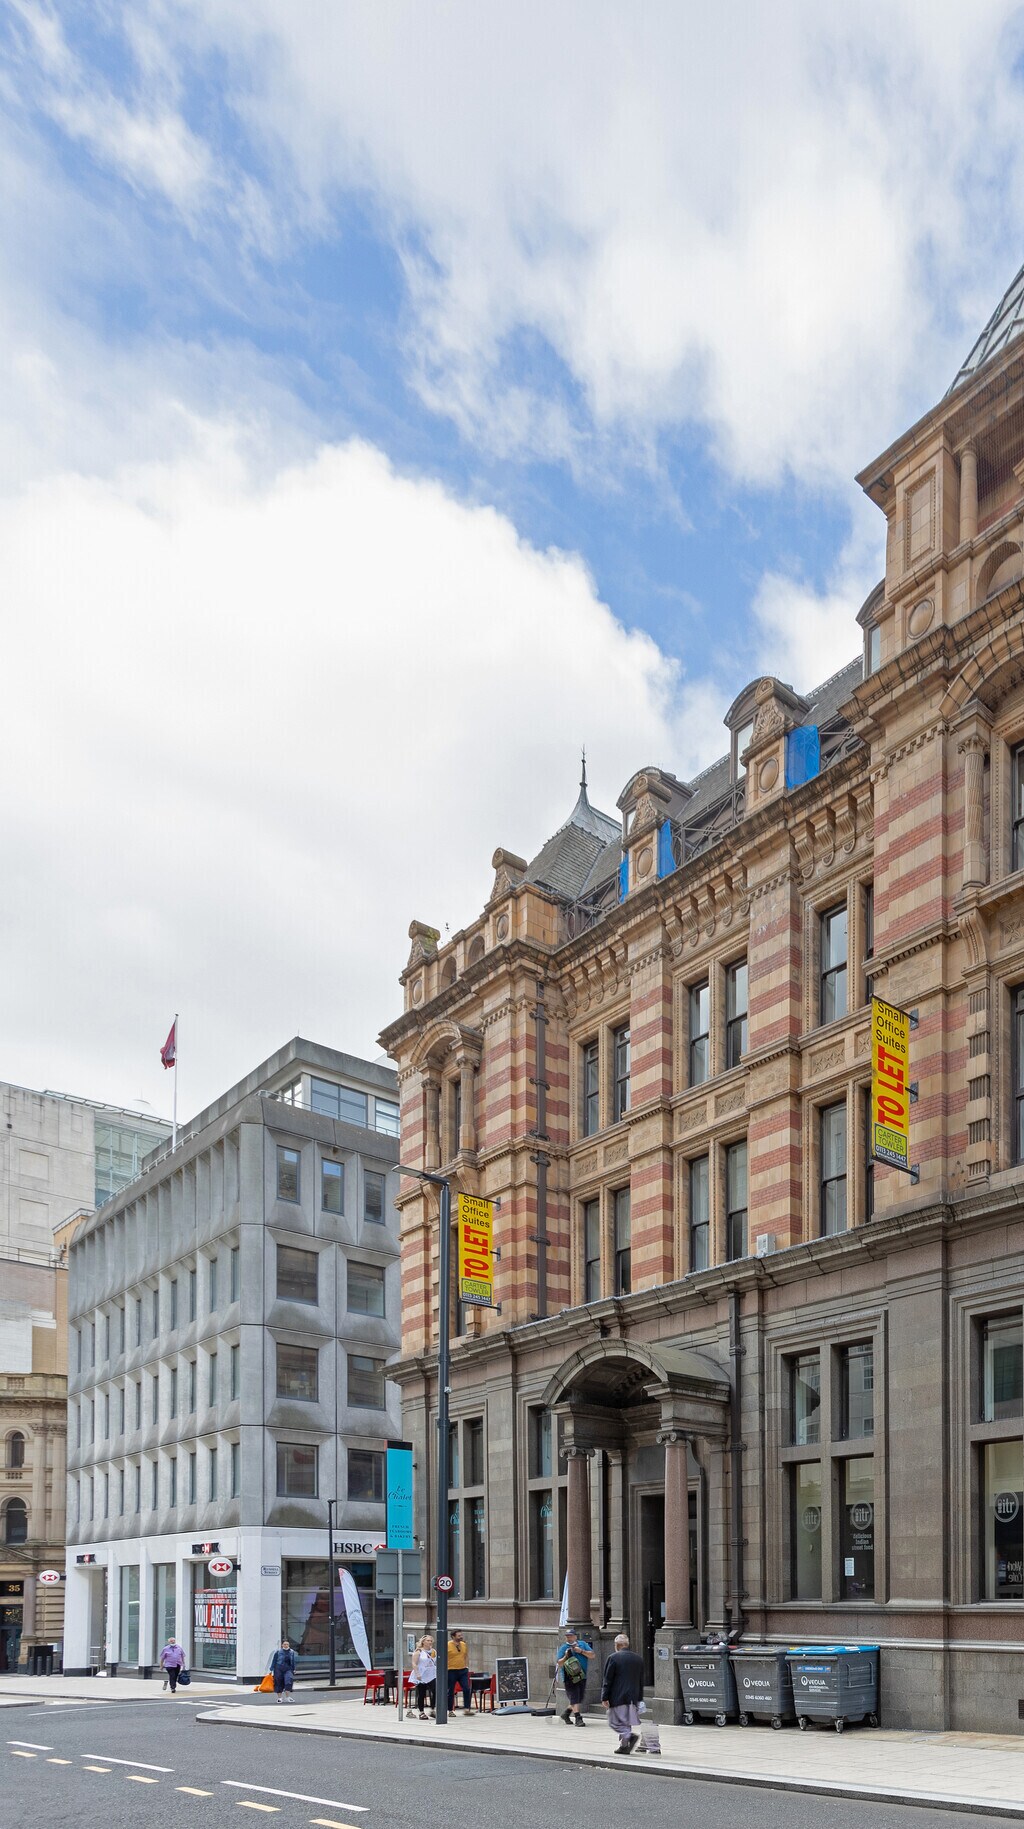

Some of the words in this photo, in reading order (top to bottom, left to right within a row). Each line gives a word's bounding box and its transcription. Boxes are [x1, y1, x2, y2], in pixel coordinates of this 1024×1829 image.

[877, 1002, 904, 1024] Small
[876, 1016, 905, 1038] Office
[876, 1029, 906, 1054] Suites
[878, 1044, 904, 1096] LET
[877, 1094, 904, 1128] TO
[878, 1129, 902, 1144] CARTER
[878, 1136, 904, 1152] TOWLER
[464, 1196, 489, 1208] Small
[462, 1205, 489, 1218] Office
[462, 1214, 490, 1228] Suites
[464, 1224, 488, 1256] LET
[464, 1258, 489, 1278] TO
[464, 1280, 486, 1290] CARTER
[465, 1286, 488, 1296] TOWLER
[388, 1490, 412, 1500] Chalet
[1003, 1498, 1014, 1513] itr
[334, 1543, 372, 1554] HSBC
[195, 1605, 208, 1626] YOU
[211, 1605, 224, 1626] ARE
